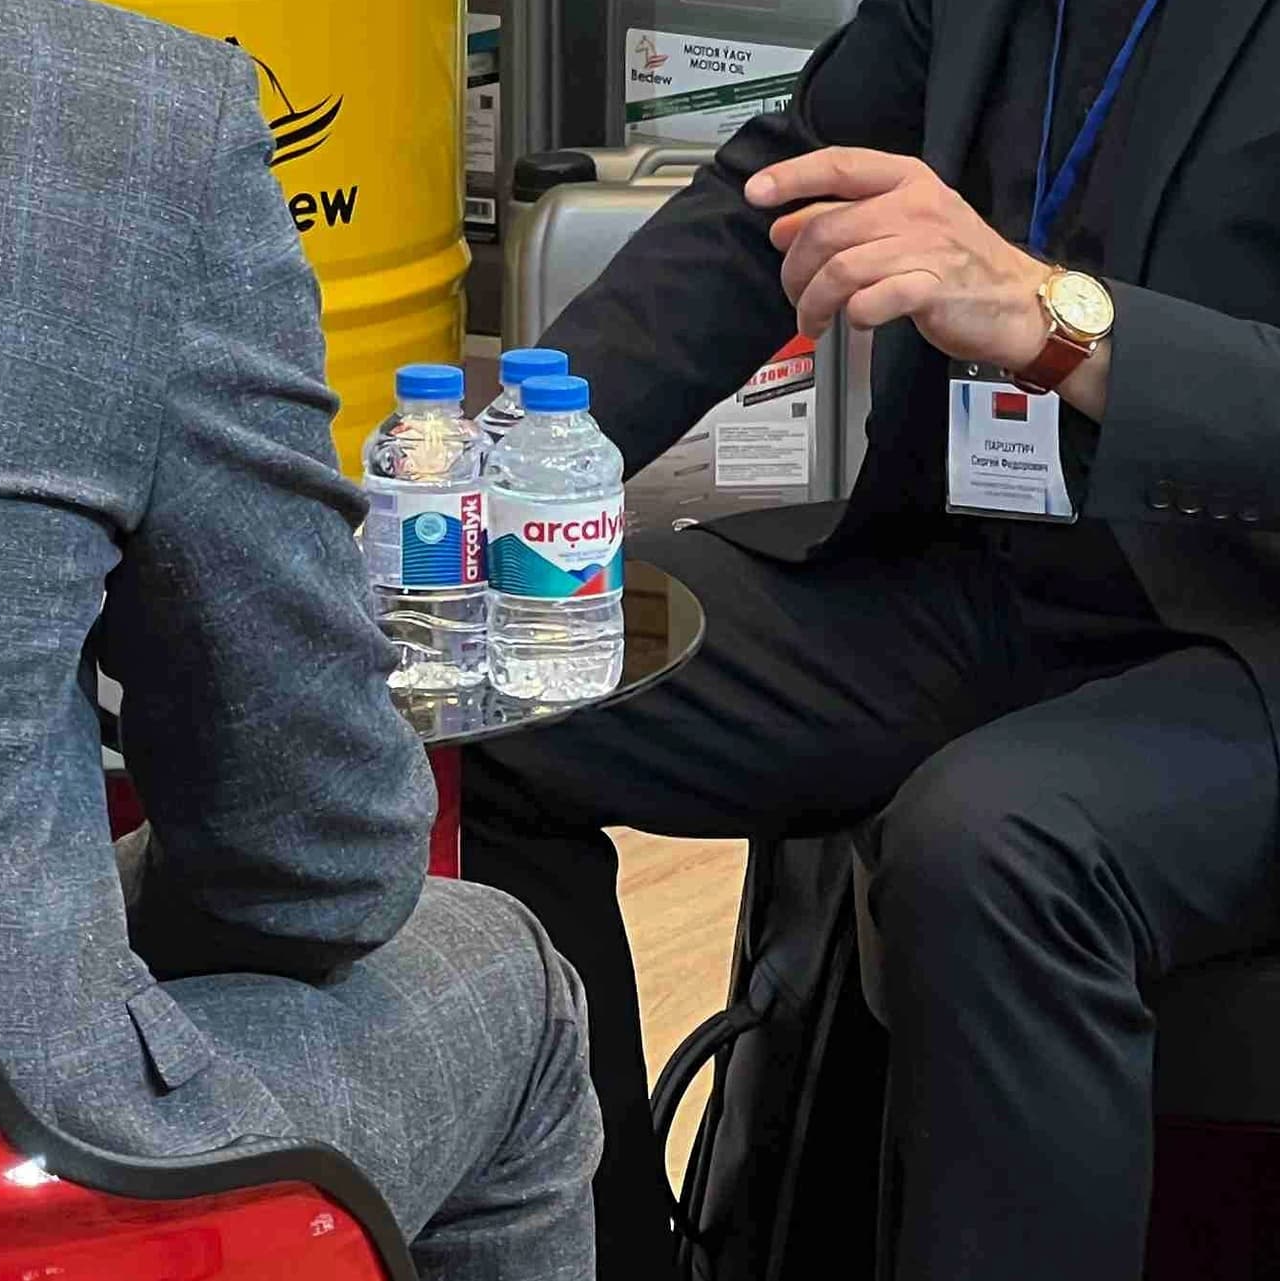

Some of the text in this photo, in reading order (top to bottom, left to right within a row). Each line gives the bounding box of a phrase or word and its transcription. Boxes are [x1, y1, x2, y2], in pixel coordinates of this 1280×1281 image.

[683, 43, 720, 58] MOTOR
[689, 59, 745, 75] MOTOR OIL
[631, 69, 673, 85] Bedew
[463, 497, 481, 580] arçalyk
